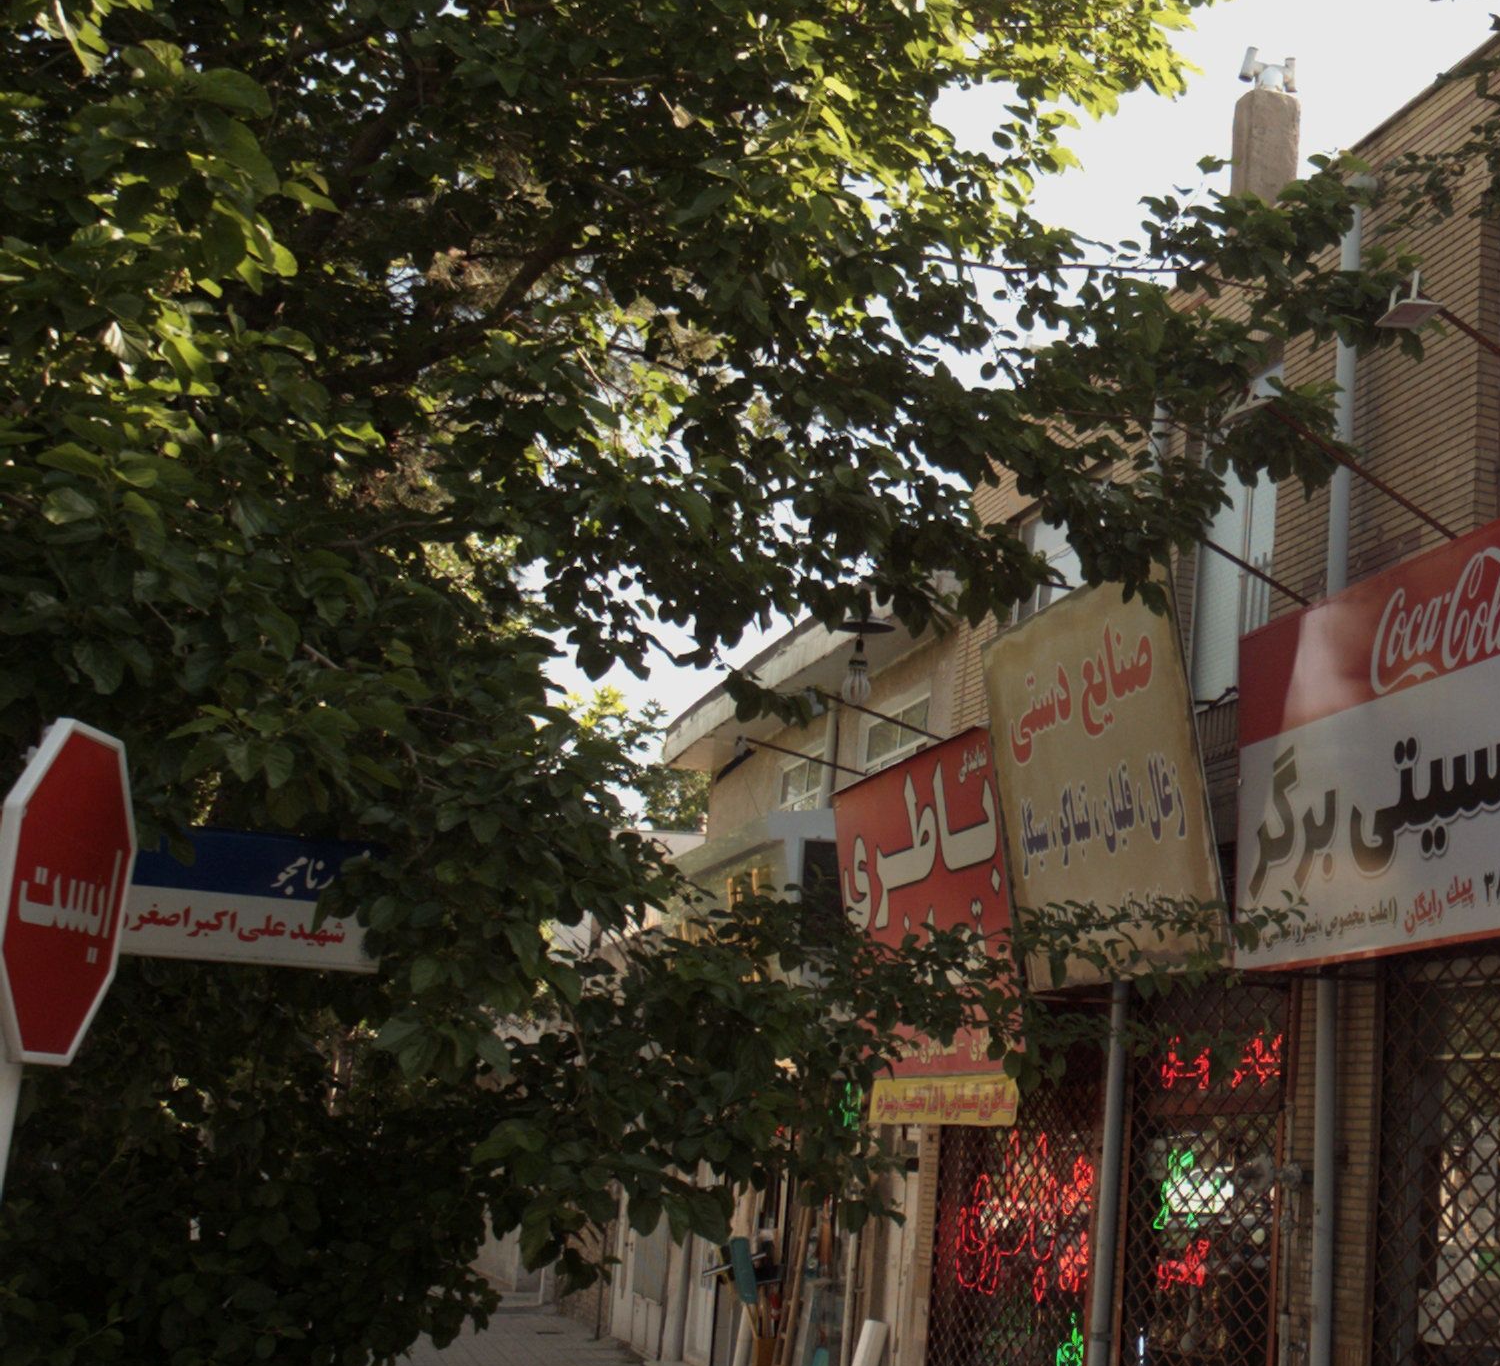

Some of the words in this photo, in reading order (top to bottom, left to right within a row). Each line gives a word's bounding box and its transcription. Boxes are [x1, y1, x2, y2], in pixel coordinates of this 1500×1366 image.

[1011, 664, 1072, 764] دستی
[1081, 621, 1152, 737] صنایع
[843, 759, 1001, 933] باطری
[1249, 746, 1338, 899] برگر
[19, 849, 122, 964] ایست
[187, 910, 237, 937] اکبر
[238, 914, 285, 942] علی
[290, 921, 345, 946] شهید
[1404, 889, 1444, 934] رایگان
